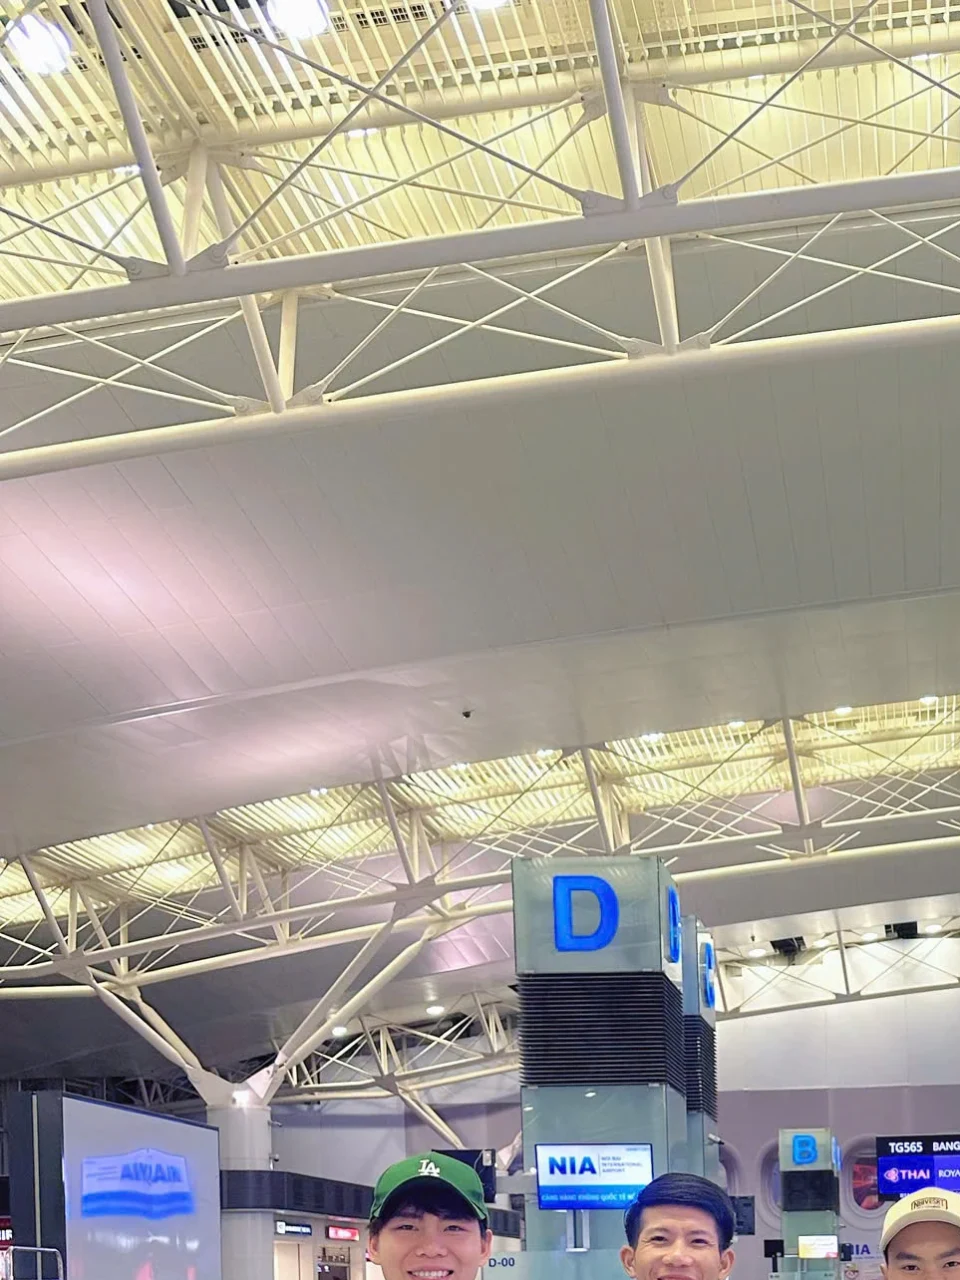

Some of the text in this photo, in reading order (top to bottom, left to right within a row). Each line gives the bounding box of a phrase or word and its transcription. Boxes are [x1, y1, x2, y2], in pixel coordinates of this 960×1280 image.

[553, 875, 619, 952] D
[792, 1133, 818, 1165] B
[889, 1142, 923, 1153] TG565
[418, 1159, 440, 1177] LA
[548, 1156, 597, 1175] NIA
[900, 1169, 931, 1180] THAI
[488, 1257, 515, 1267] D-00
